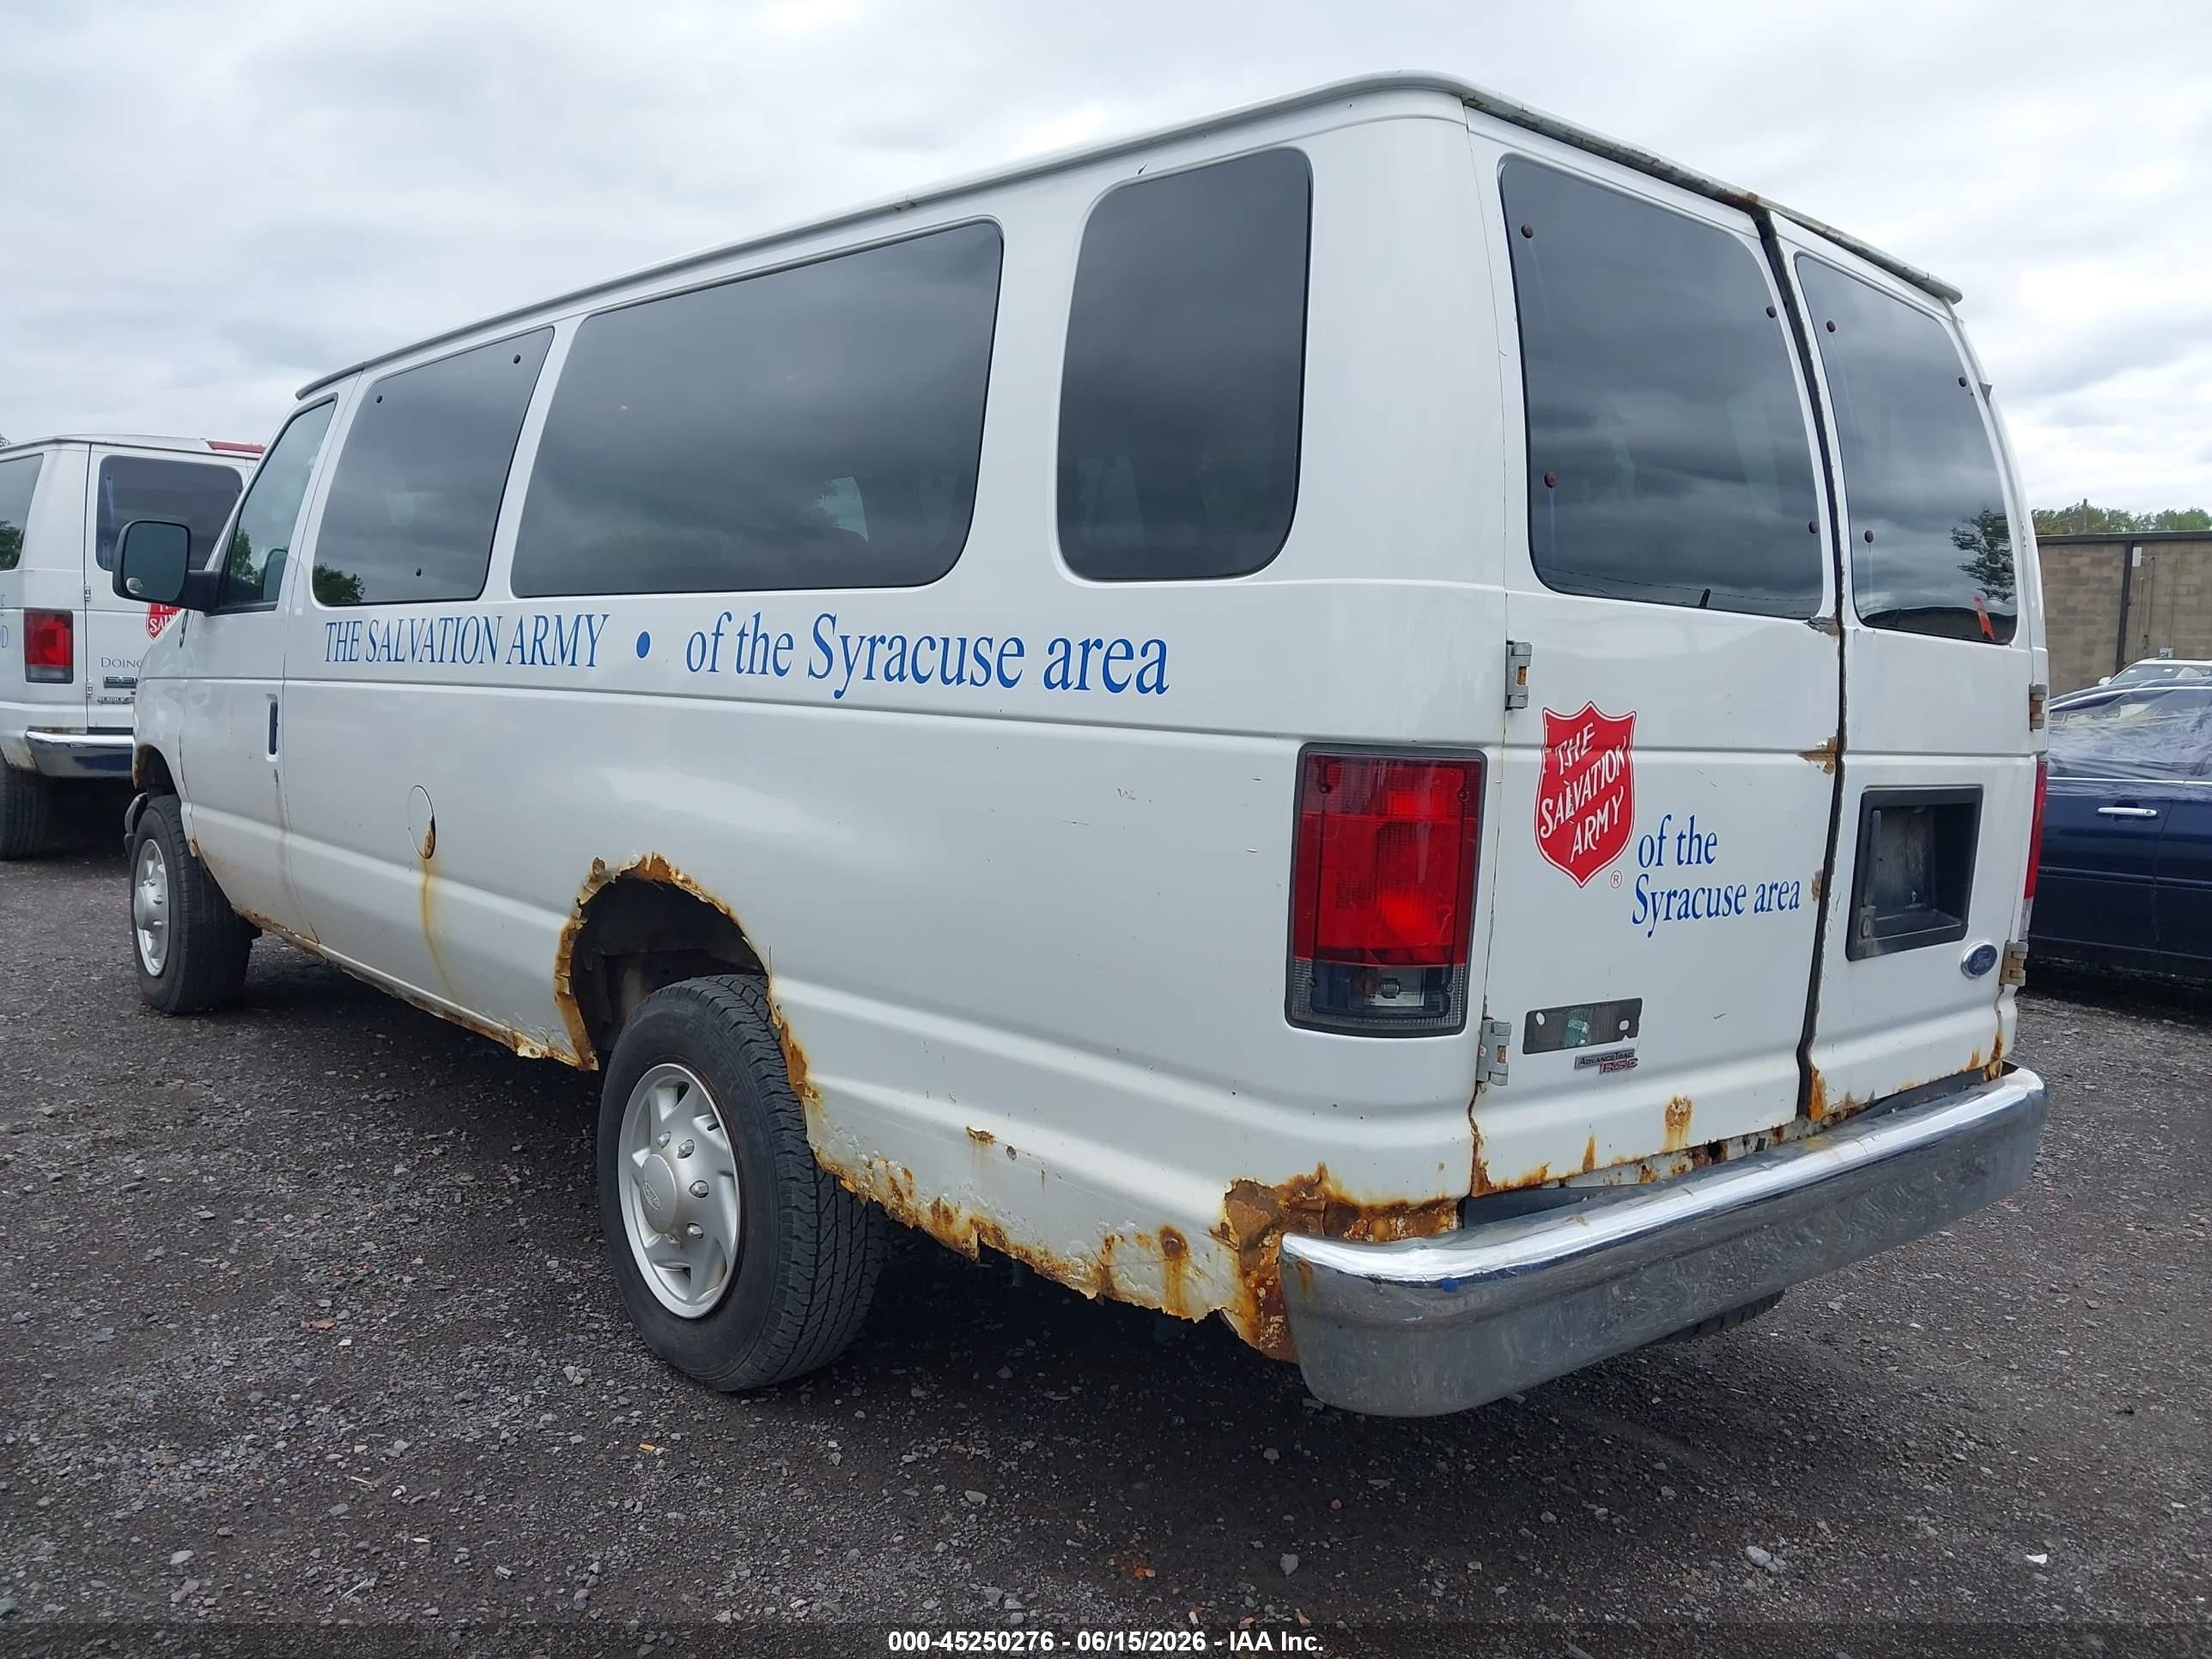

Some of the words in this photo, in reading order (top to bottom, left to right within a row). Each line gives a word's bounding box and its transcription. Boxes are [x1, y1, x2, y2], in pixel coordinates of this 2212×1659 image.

[324, 619, 361, 662] THE
[366, 616, 503, 665] SALVATION
[506, 613, 611, 667] ARMY
[686, 611, 732, 673] of
[736, 611, 794, 678] the
[807, 611, 1025, 700] Syracuse
[1042, 636, 1170, 695] area
[1555, 722, 1595, 775] THE
[1540, 735, 1627, 839] SALVATION
[1570, 785, 1625, 863] ARMY
[1638, 814, 1672, 868] of
[1677, 814, 1717, 866] the
[1632, 873, 1747, 939] Syracuse
[1753, 880, 1801, 915] area
[1601, 1057, 1639, 1073] RSC
